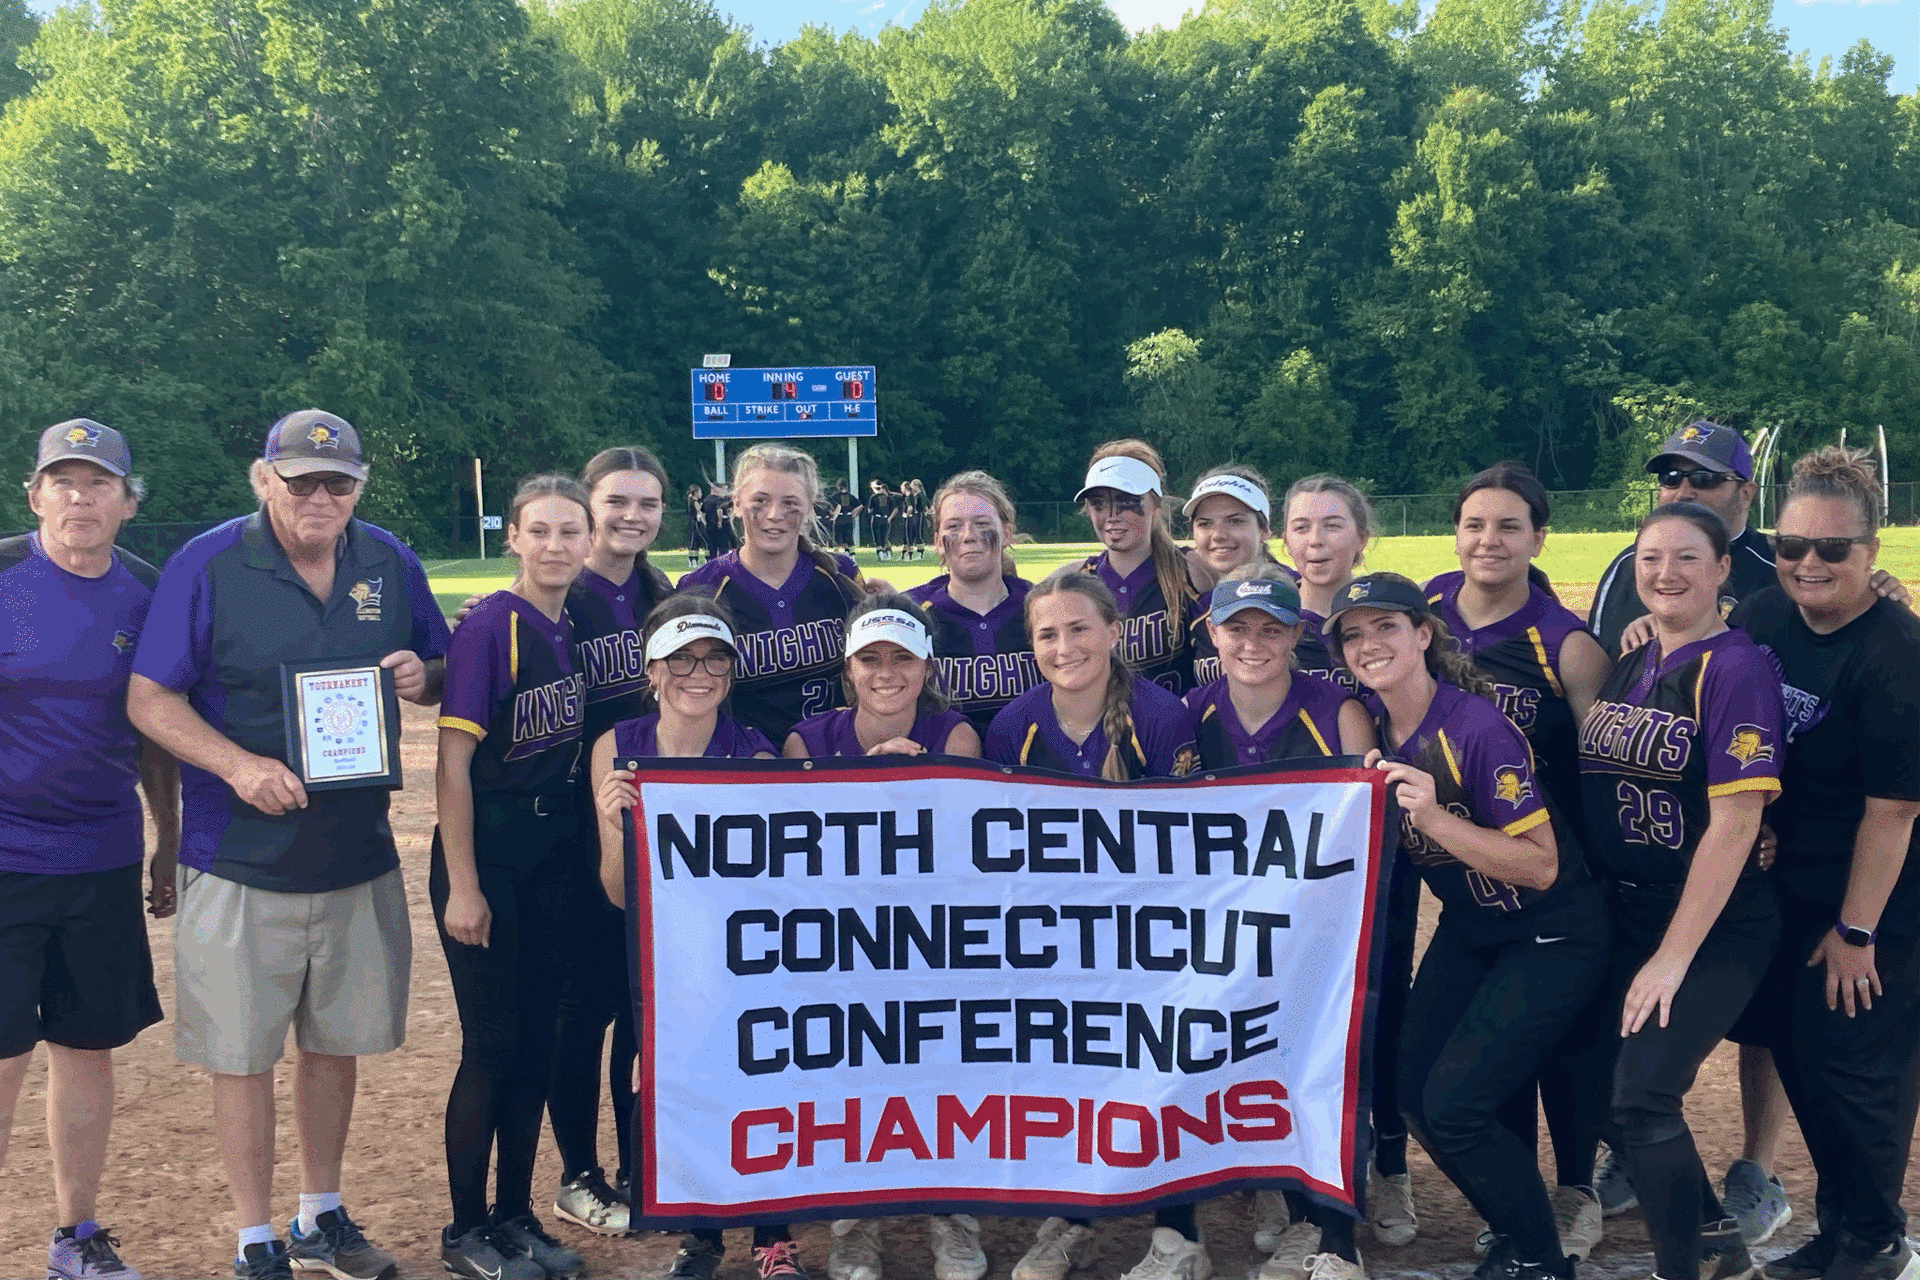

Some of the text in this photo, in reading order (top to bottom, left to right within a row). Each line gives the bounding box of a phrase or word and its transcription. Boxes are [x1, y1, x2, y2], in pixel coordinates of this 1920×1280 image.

[699, 370, 870, 383] HOME INNING GUEST
[713, 382, 725, 400] 0
[851, 380, 863, 399] 0
[704, 406, 729, 415] BALL
[745, 405, 779, 414] STRIKE
[795, 405, 817, 413] OUT
[735, 618, 846, 679] NIGHTS
[309, 678, 368, 691] TOURNAMENT
[656, 808, 934, 880] NORTH
[971, 807, 1355, 880] CENTRAL
[1617, 780, 1684, 849] 29
[726, 904, 1290, 977] CONNECTICUT
[737, 998, 1280, 1076] CONFERENCE
[730, 1079, 1293, 1175] CHAMPIONS
